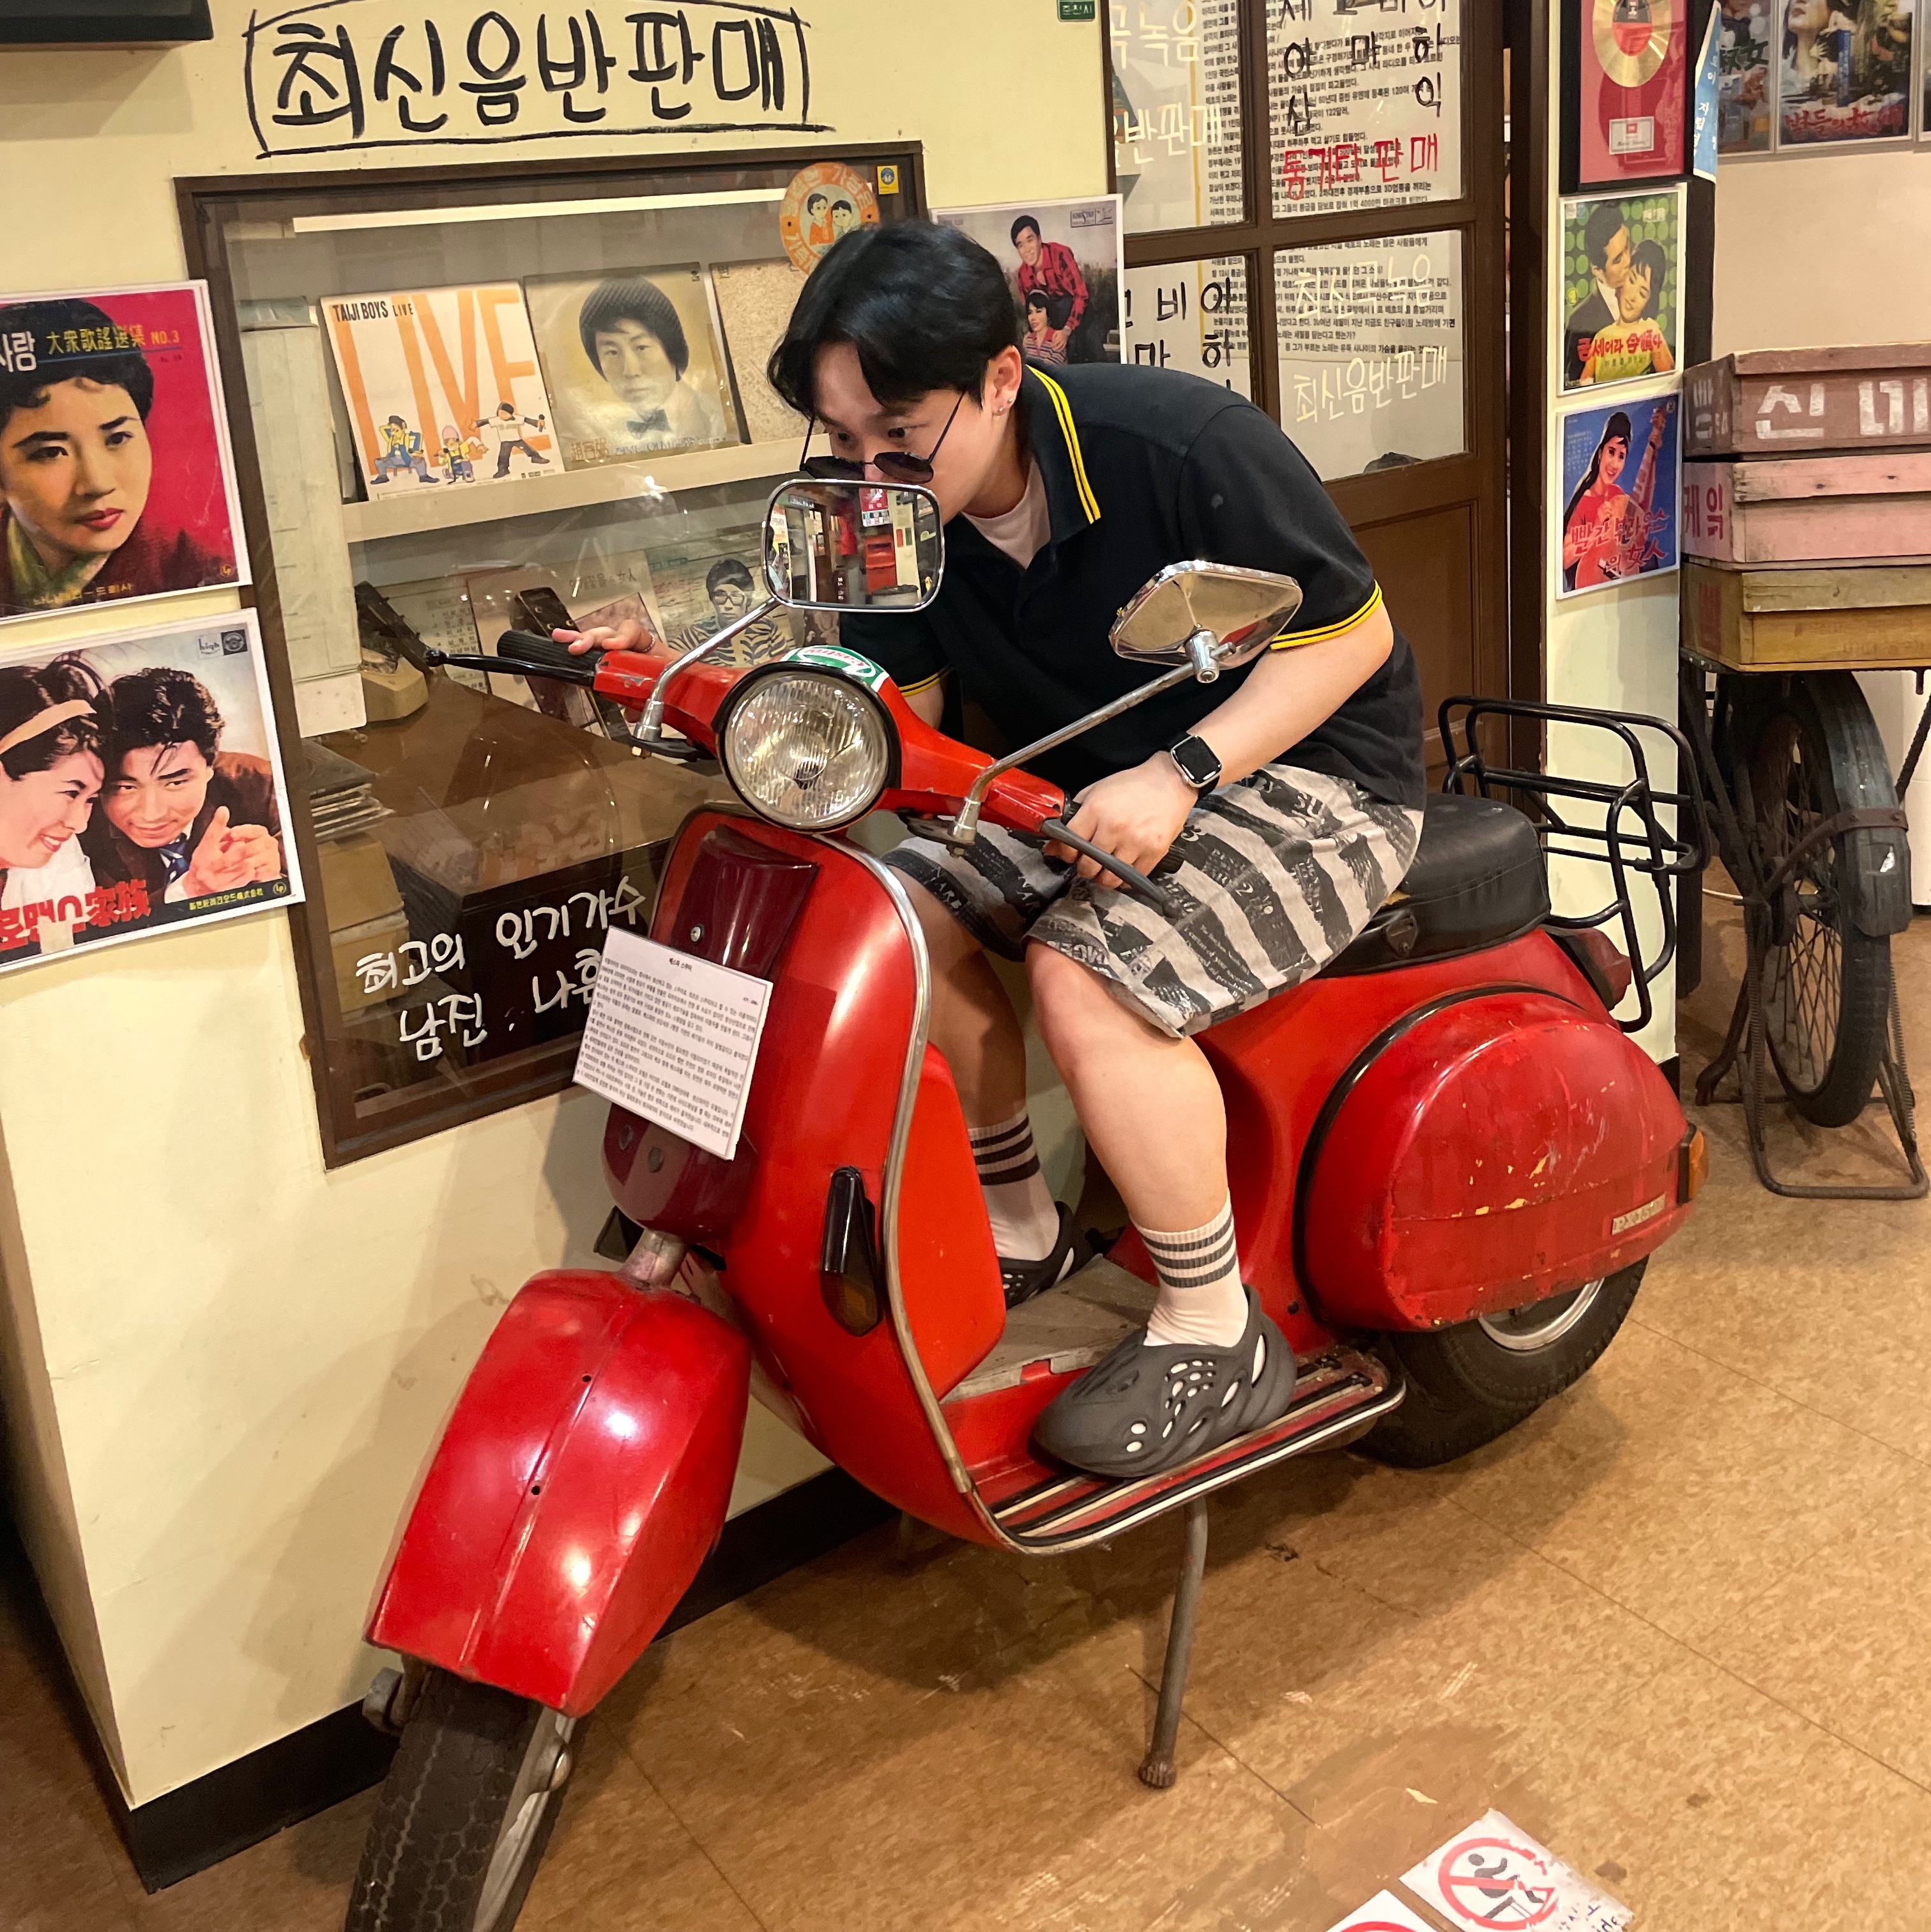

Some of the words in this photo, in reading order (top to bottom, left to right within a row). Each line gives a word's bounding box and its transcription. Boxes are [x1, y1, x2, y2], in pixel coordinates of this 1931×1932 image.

[272, 10, 784, 138] 최신음반판매
[1283, 143, 1364, 201] 통기타
[1374, 133, 1438, 183] 판매
[333, 302, 360, 322] TAIJI
[362, 300, 388, 320] BOYS
[392, 303, 414, 317] LIVE
[1157, 281, 1187, 321] 비
[1294, 254, 1433, 321] 최신곡녹음
[329, 289, 553, 476] LIVE
[1294, 346, 1447, 422] 최신음반판매
[1570, 521, 1610, 555] 빨간
[356, 931, 466, 994] 최고의
[496, 874, 646, 960] 인기가수
[399, 992, 488, 1062] 남진
